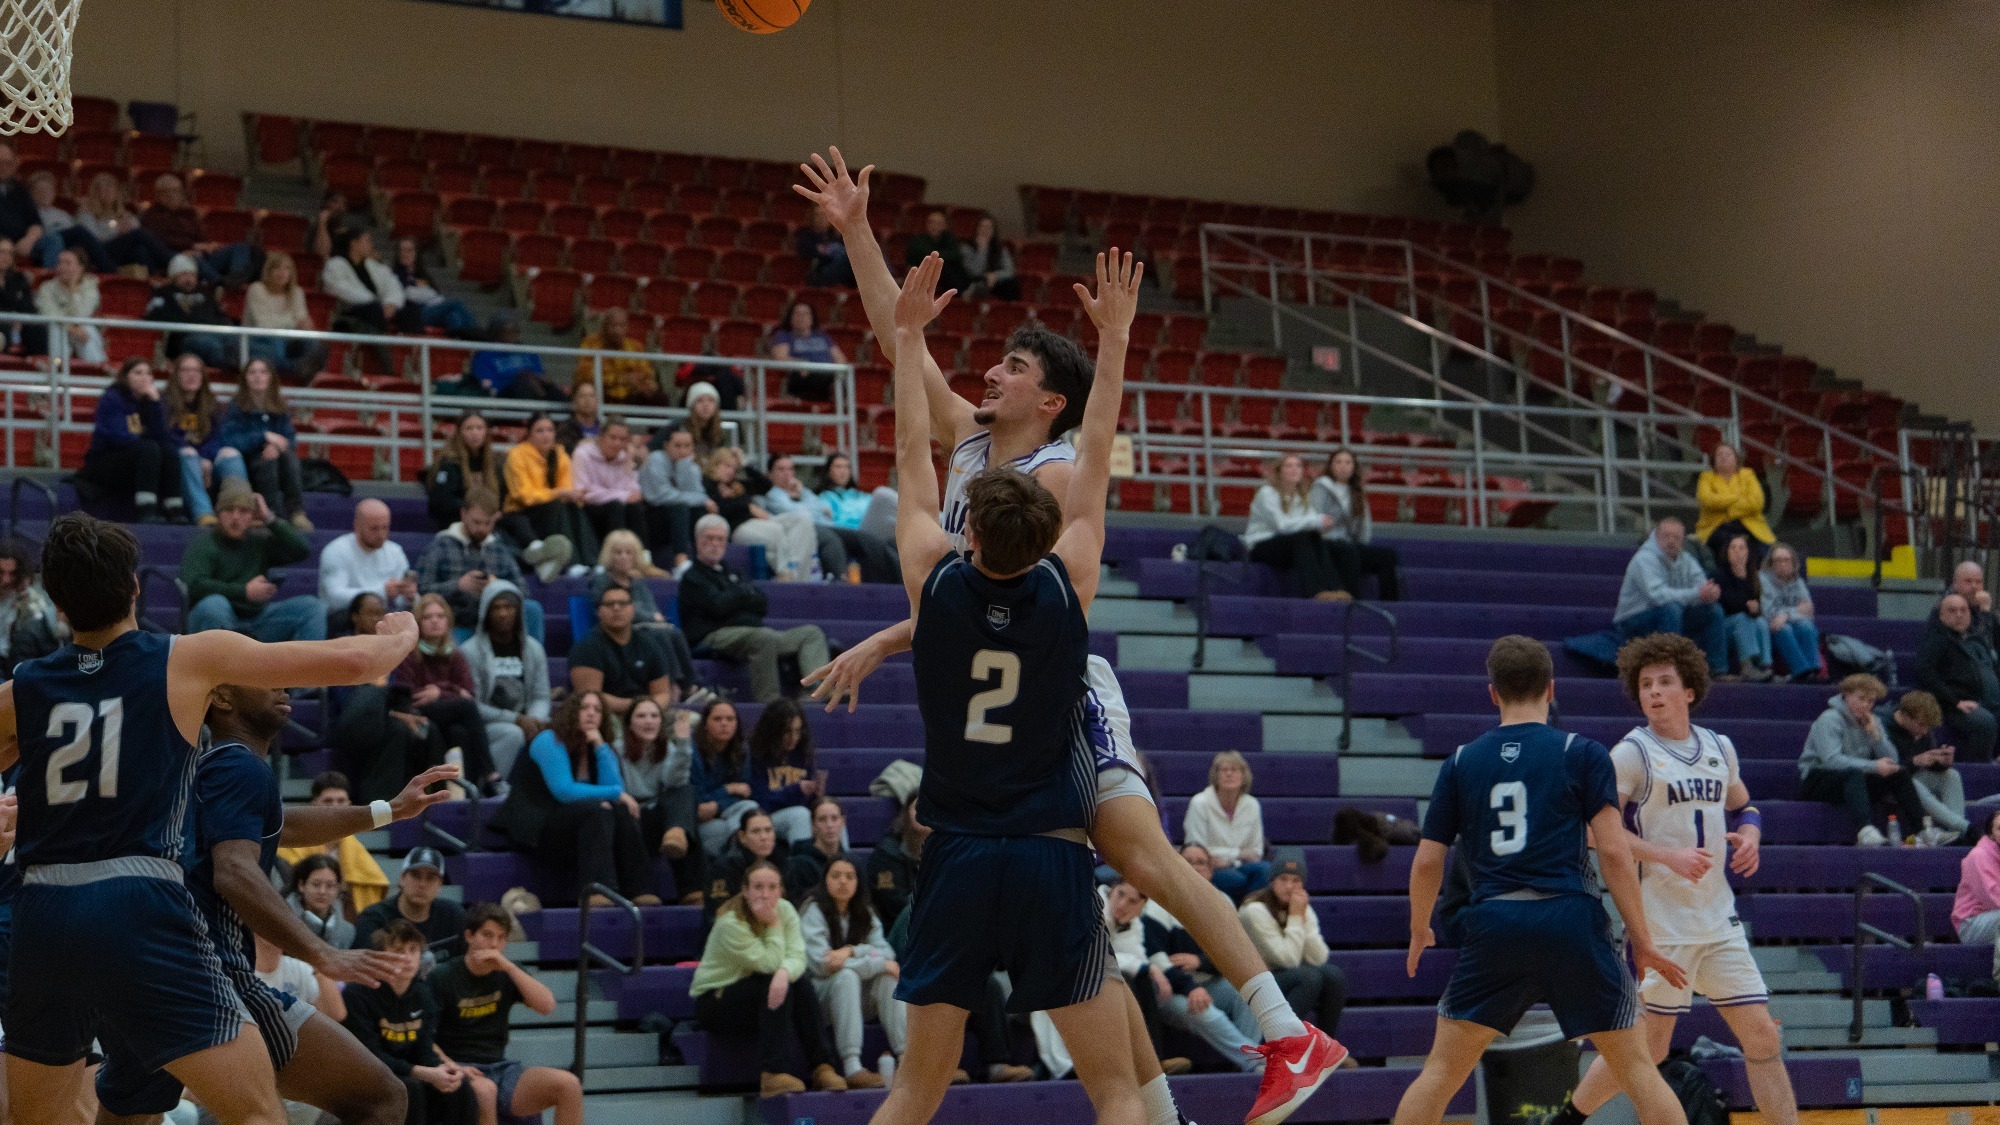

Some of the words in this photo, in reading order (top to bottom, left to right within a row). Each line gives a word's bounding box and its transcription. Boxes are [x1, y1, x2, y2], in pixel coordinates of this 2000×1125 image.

[78, 659, 104, 670] KNIGHT
[82, 653, 99, 662] ONE
[964, 648, 1021, 744] 2
[45, 696, 124, 806] 21
[1667, 778, 1723, 806] ALFRED
[1490, 780, 1528, 857] 3
[1694, 809, 1705, 849] 1
